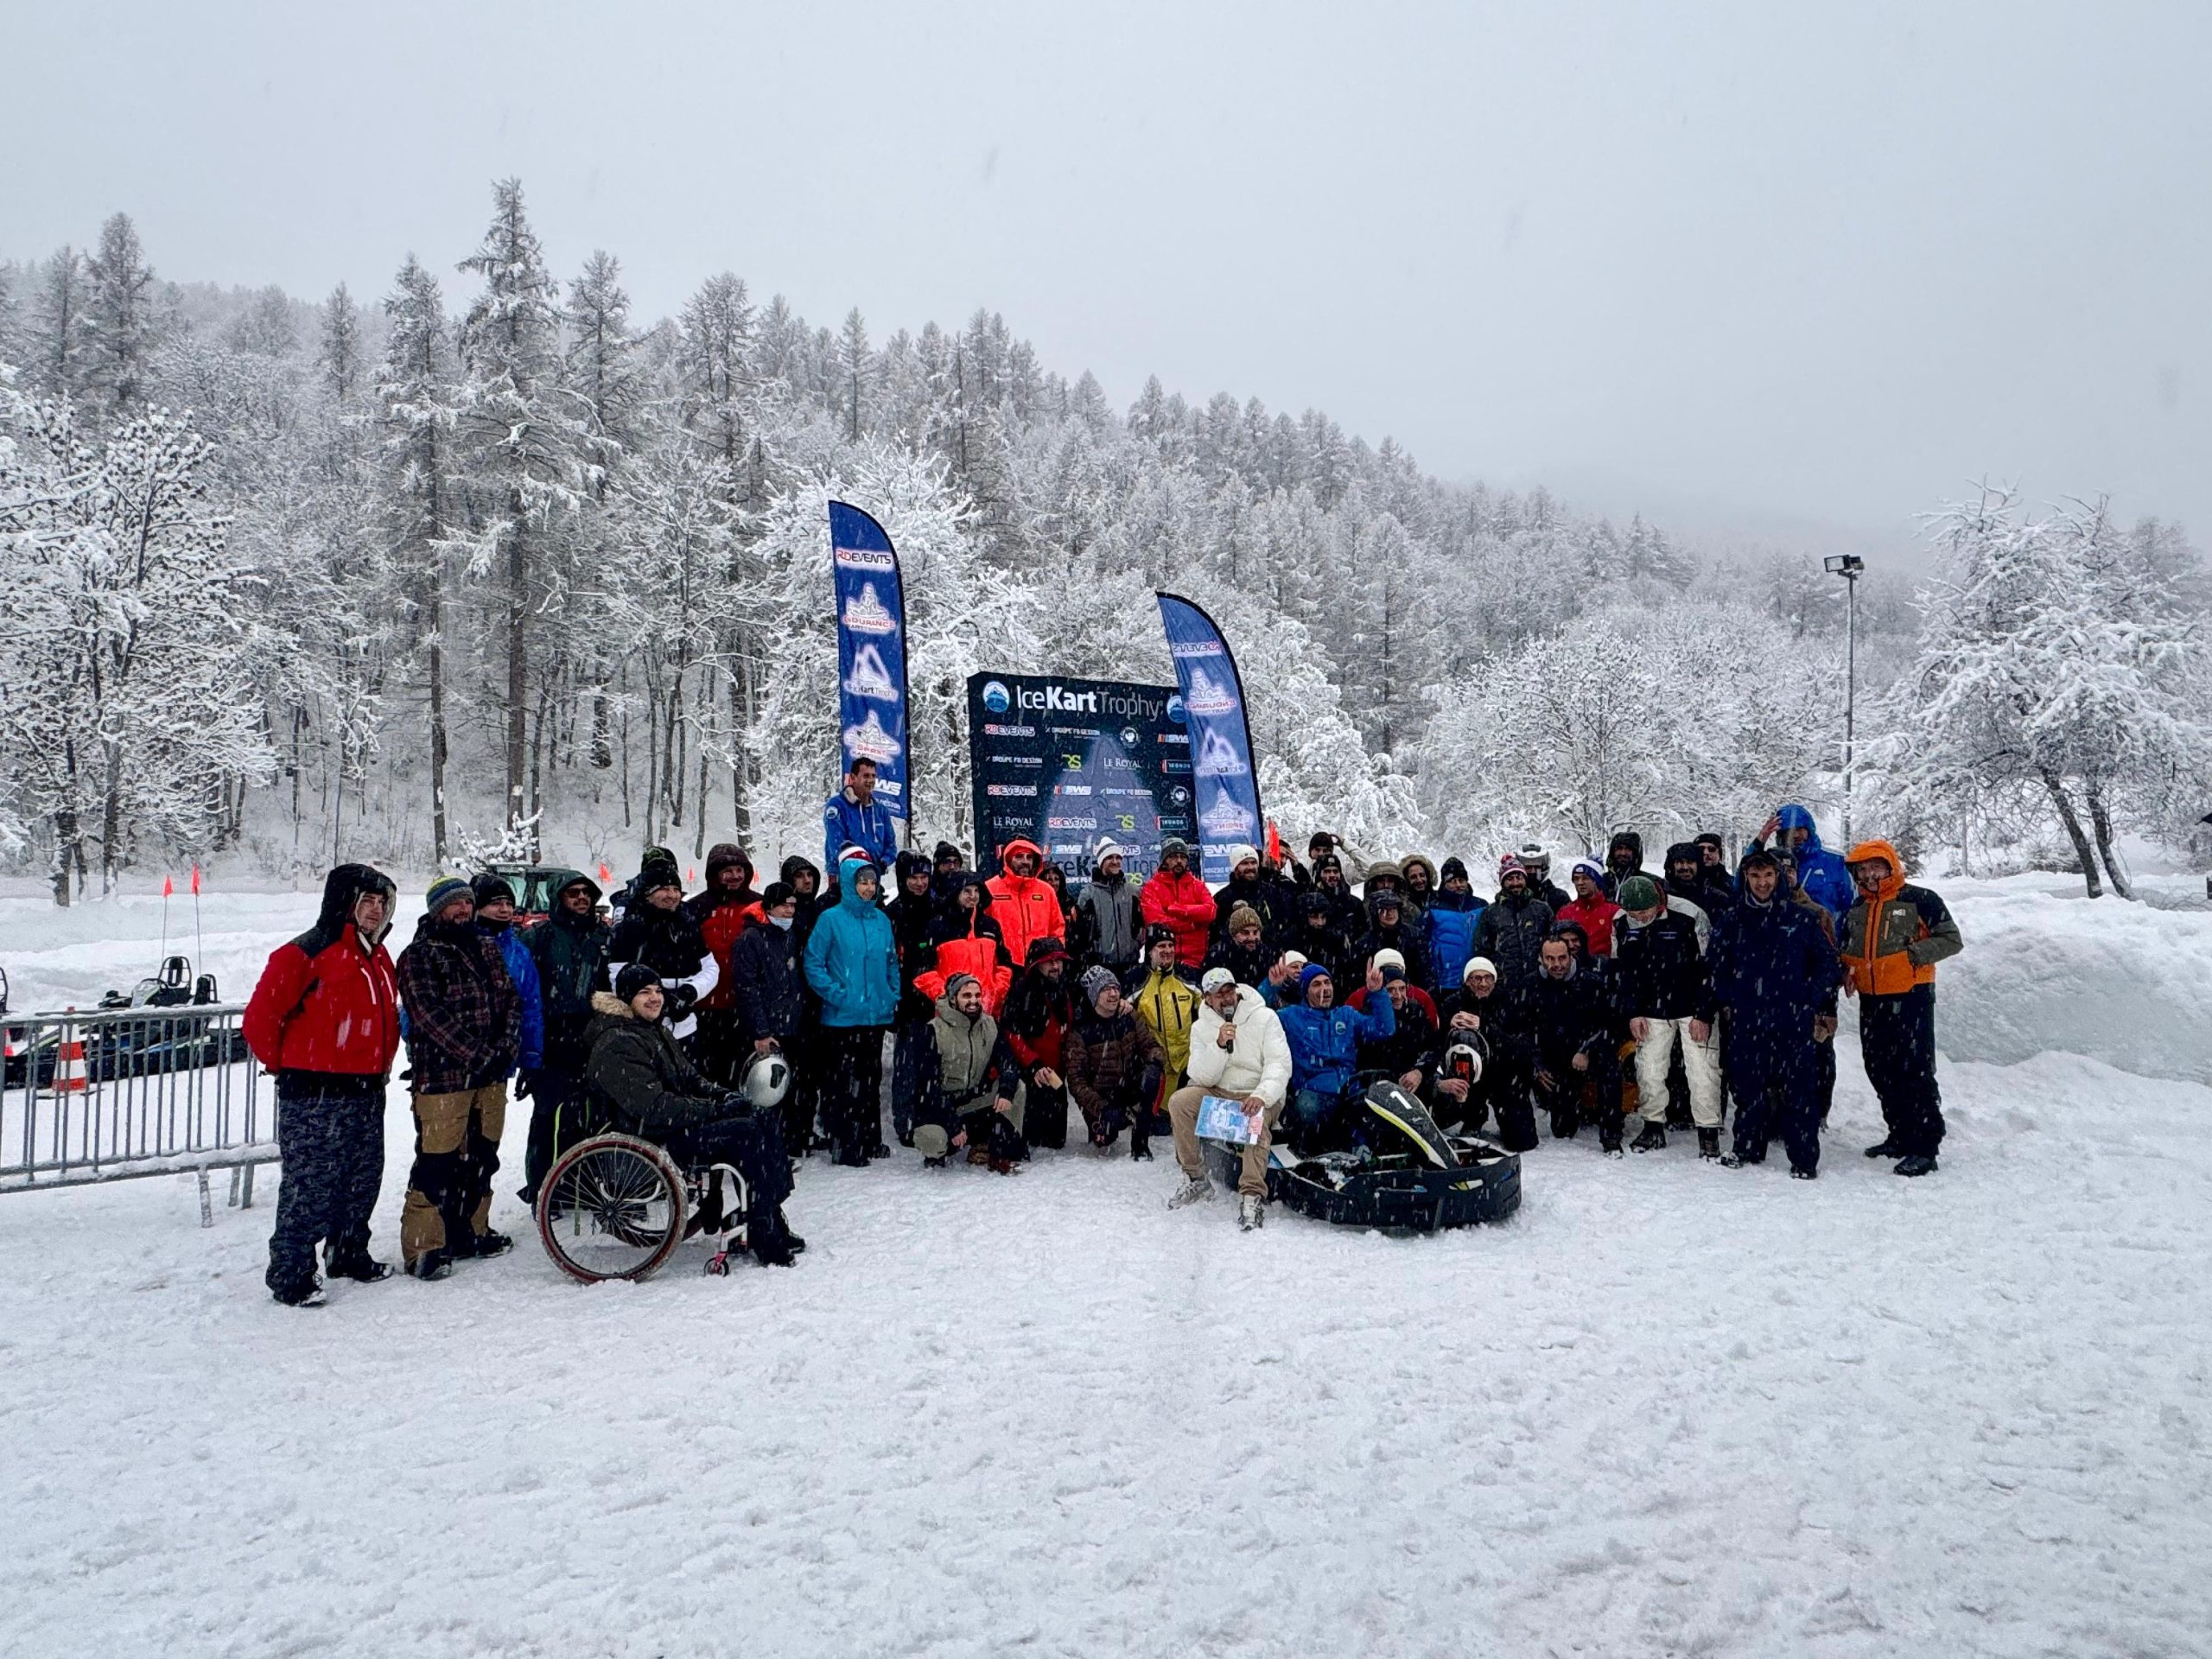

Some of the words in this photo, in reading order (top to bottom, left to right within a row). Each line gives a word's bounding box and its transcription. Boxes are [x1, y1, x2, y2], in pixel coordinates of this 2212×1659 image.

[836, 550, 892, 564] RDEVENTS
[1016, 684, 1160, 721] IceKartTrophy
[873, 778, 902, 797] WS
[1005, 817, 1034, 827] ROYAL
[1389, 1090, 1413, 1110] 1
